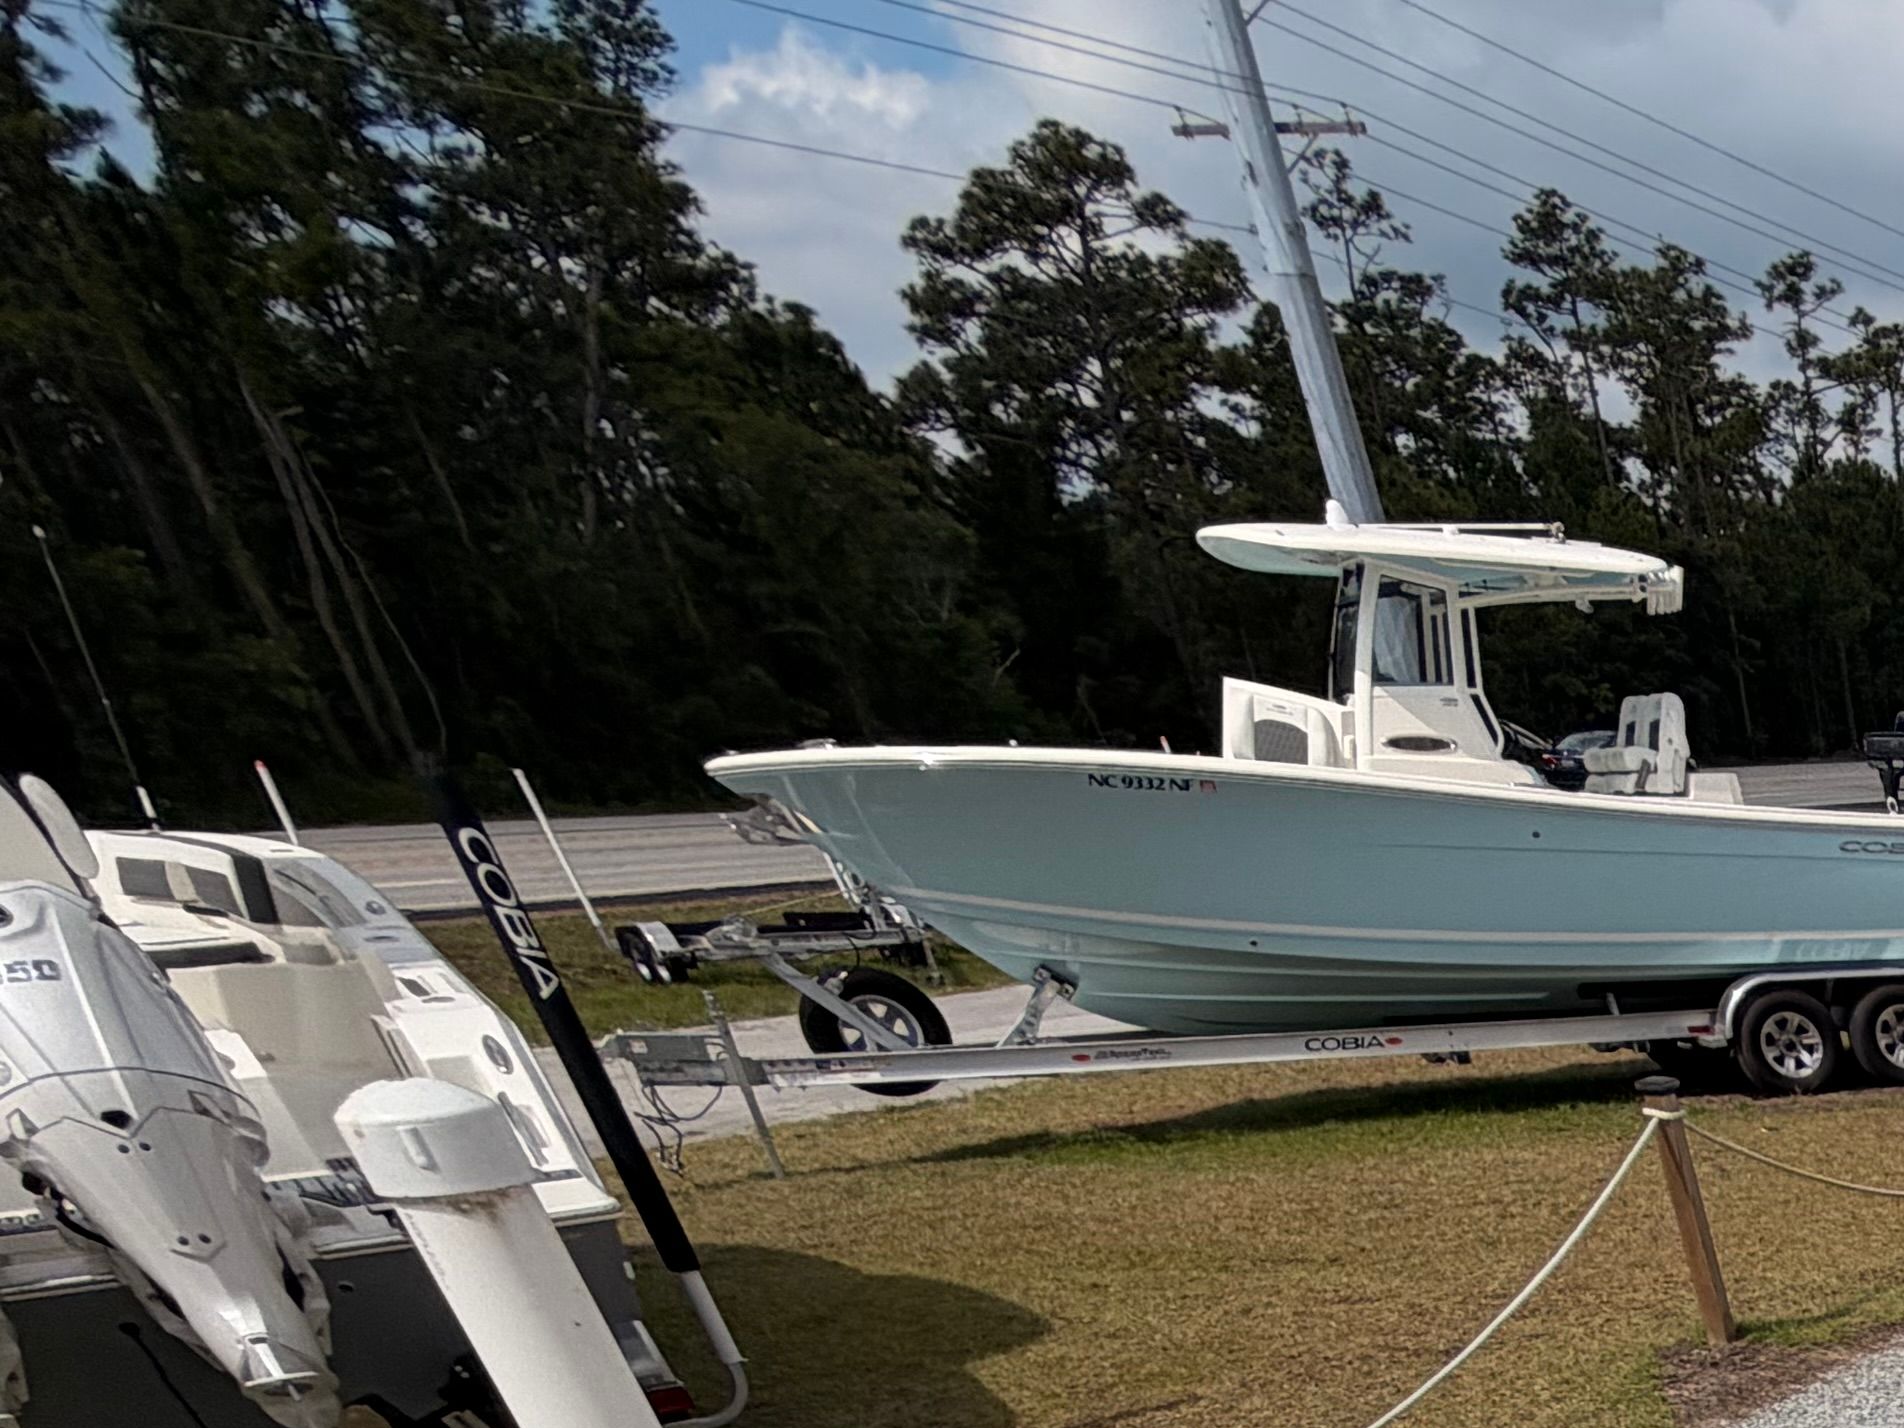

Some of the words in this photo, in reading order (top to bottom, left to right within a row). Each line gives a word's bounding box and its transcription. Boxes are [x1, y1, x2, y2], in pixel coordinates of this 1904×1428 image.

[1088, 773, 1117, 788] NC
[1121, 776, 1165, 790] 9332
[457, 826, 561, 999] COBIA
[0, 959, 62, 985] 50
[1304, 1035, 1386, 1052] COBIA
